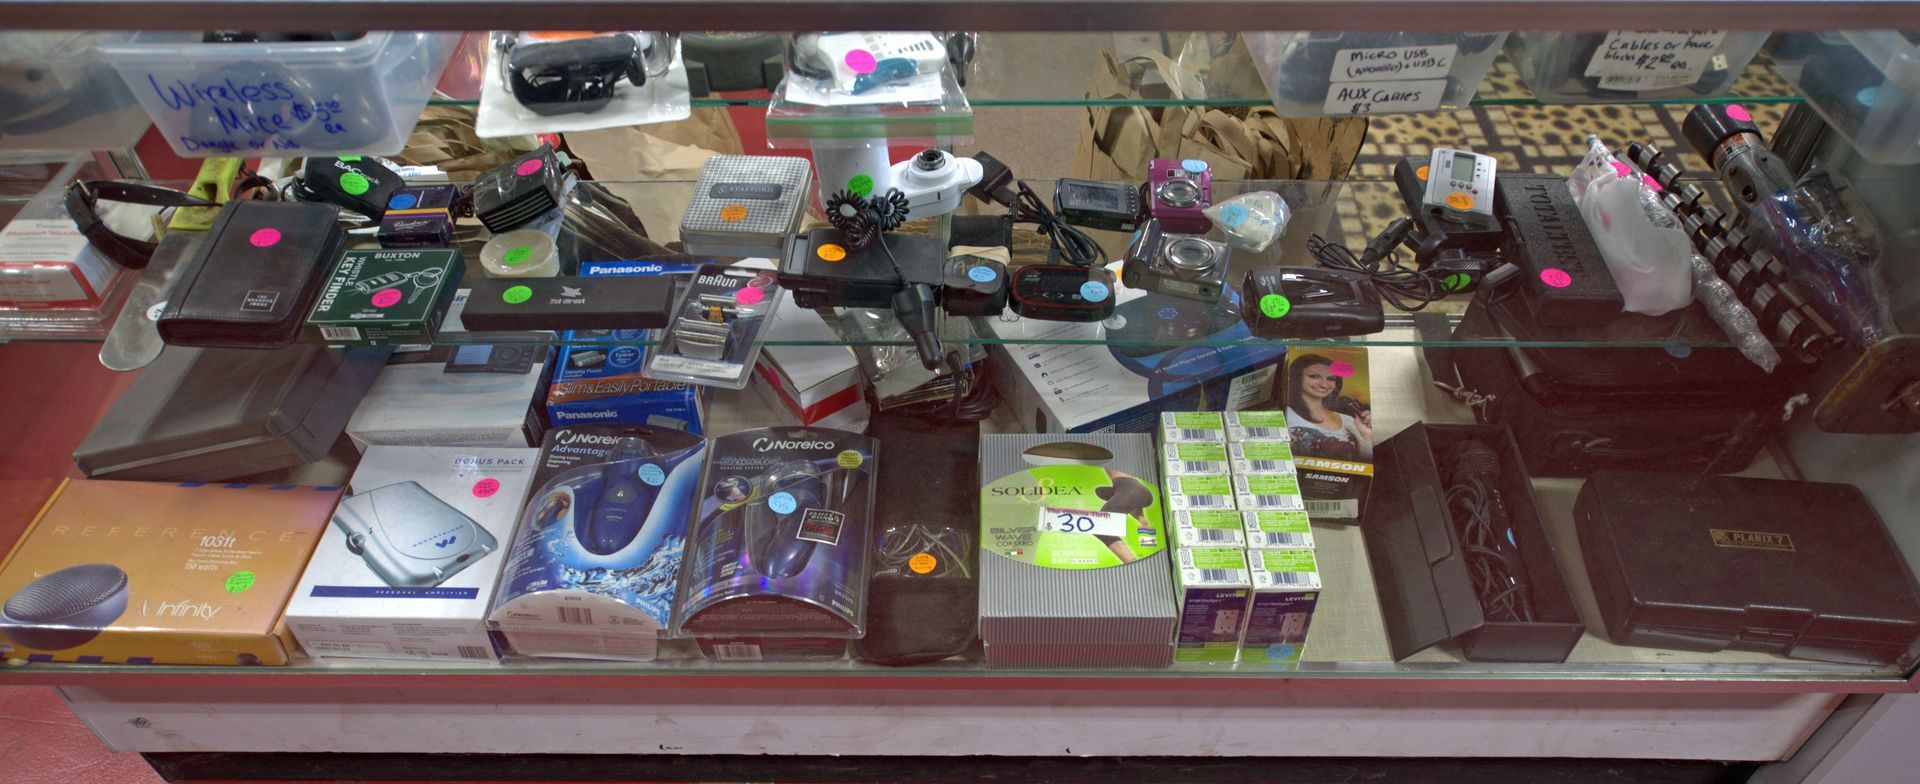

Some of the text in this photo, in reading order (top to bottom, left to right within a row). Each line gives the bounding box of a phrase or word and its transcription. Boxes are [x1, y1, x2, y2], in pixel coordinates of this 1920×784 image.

[1609, 39, 1658, 50] Cables
[1404, 48, 1430, 60] USB
[148, 74, 294, 110] Wireless
[1337, 87, 1372, 101] AUX
[213, 106, 293, 135] Mice
[345, 256, 367, 287] WHISTLE
[589, 264, 664, 275] Panasonic
[317, 257, 357, 312] KEY FINDER
[698, 274, 738, 288] BRAUN
[556, 409, 619, 421] Panasonic
[774, 440, 835, 450] Norelco
[1294, 458, 1367, 473] SAMSON
[1305, 472, 1350, 483] SAMSON
[991, 486, 1082, 497] SOLIDEA
[1057, 513, 1095, 532] 30
[51, 525, 296, 542] REFERENCE
[990, 526, 1037, 535] SILVER
[996, 540, 1034, 548] CORSARO
[1733, 533, 1774, 543] PLANIX
[156, 599, 222, 621] Infinity
[635, 598, 661, 615] PHILIPS
